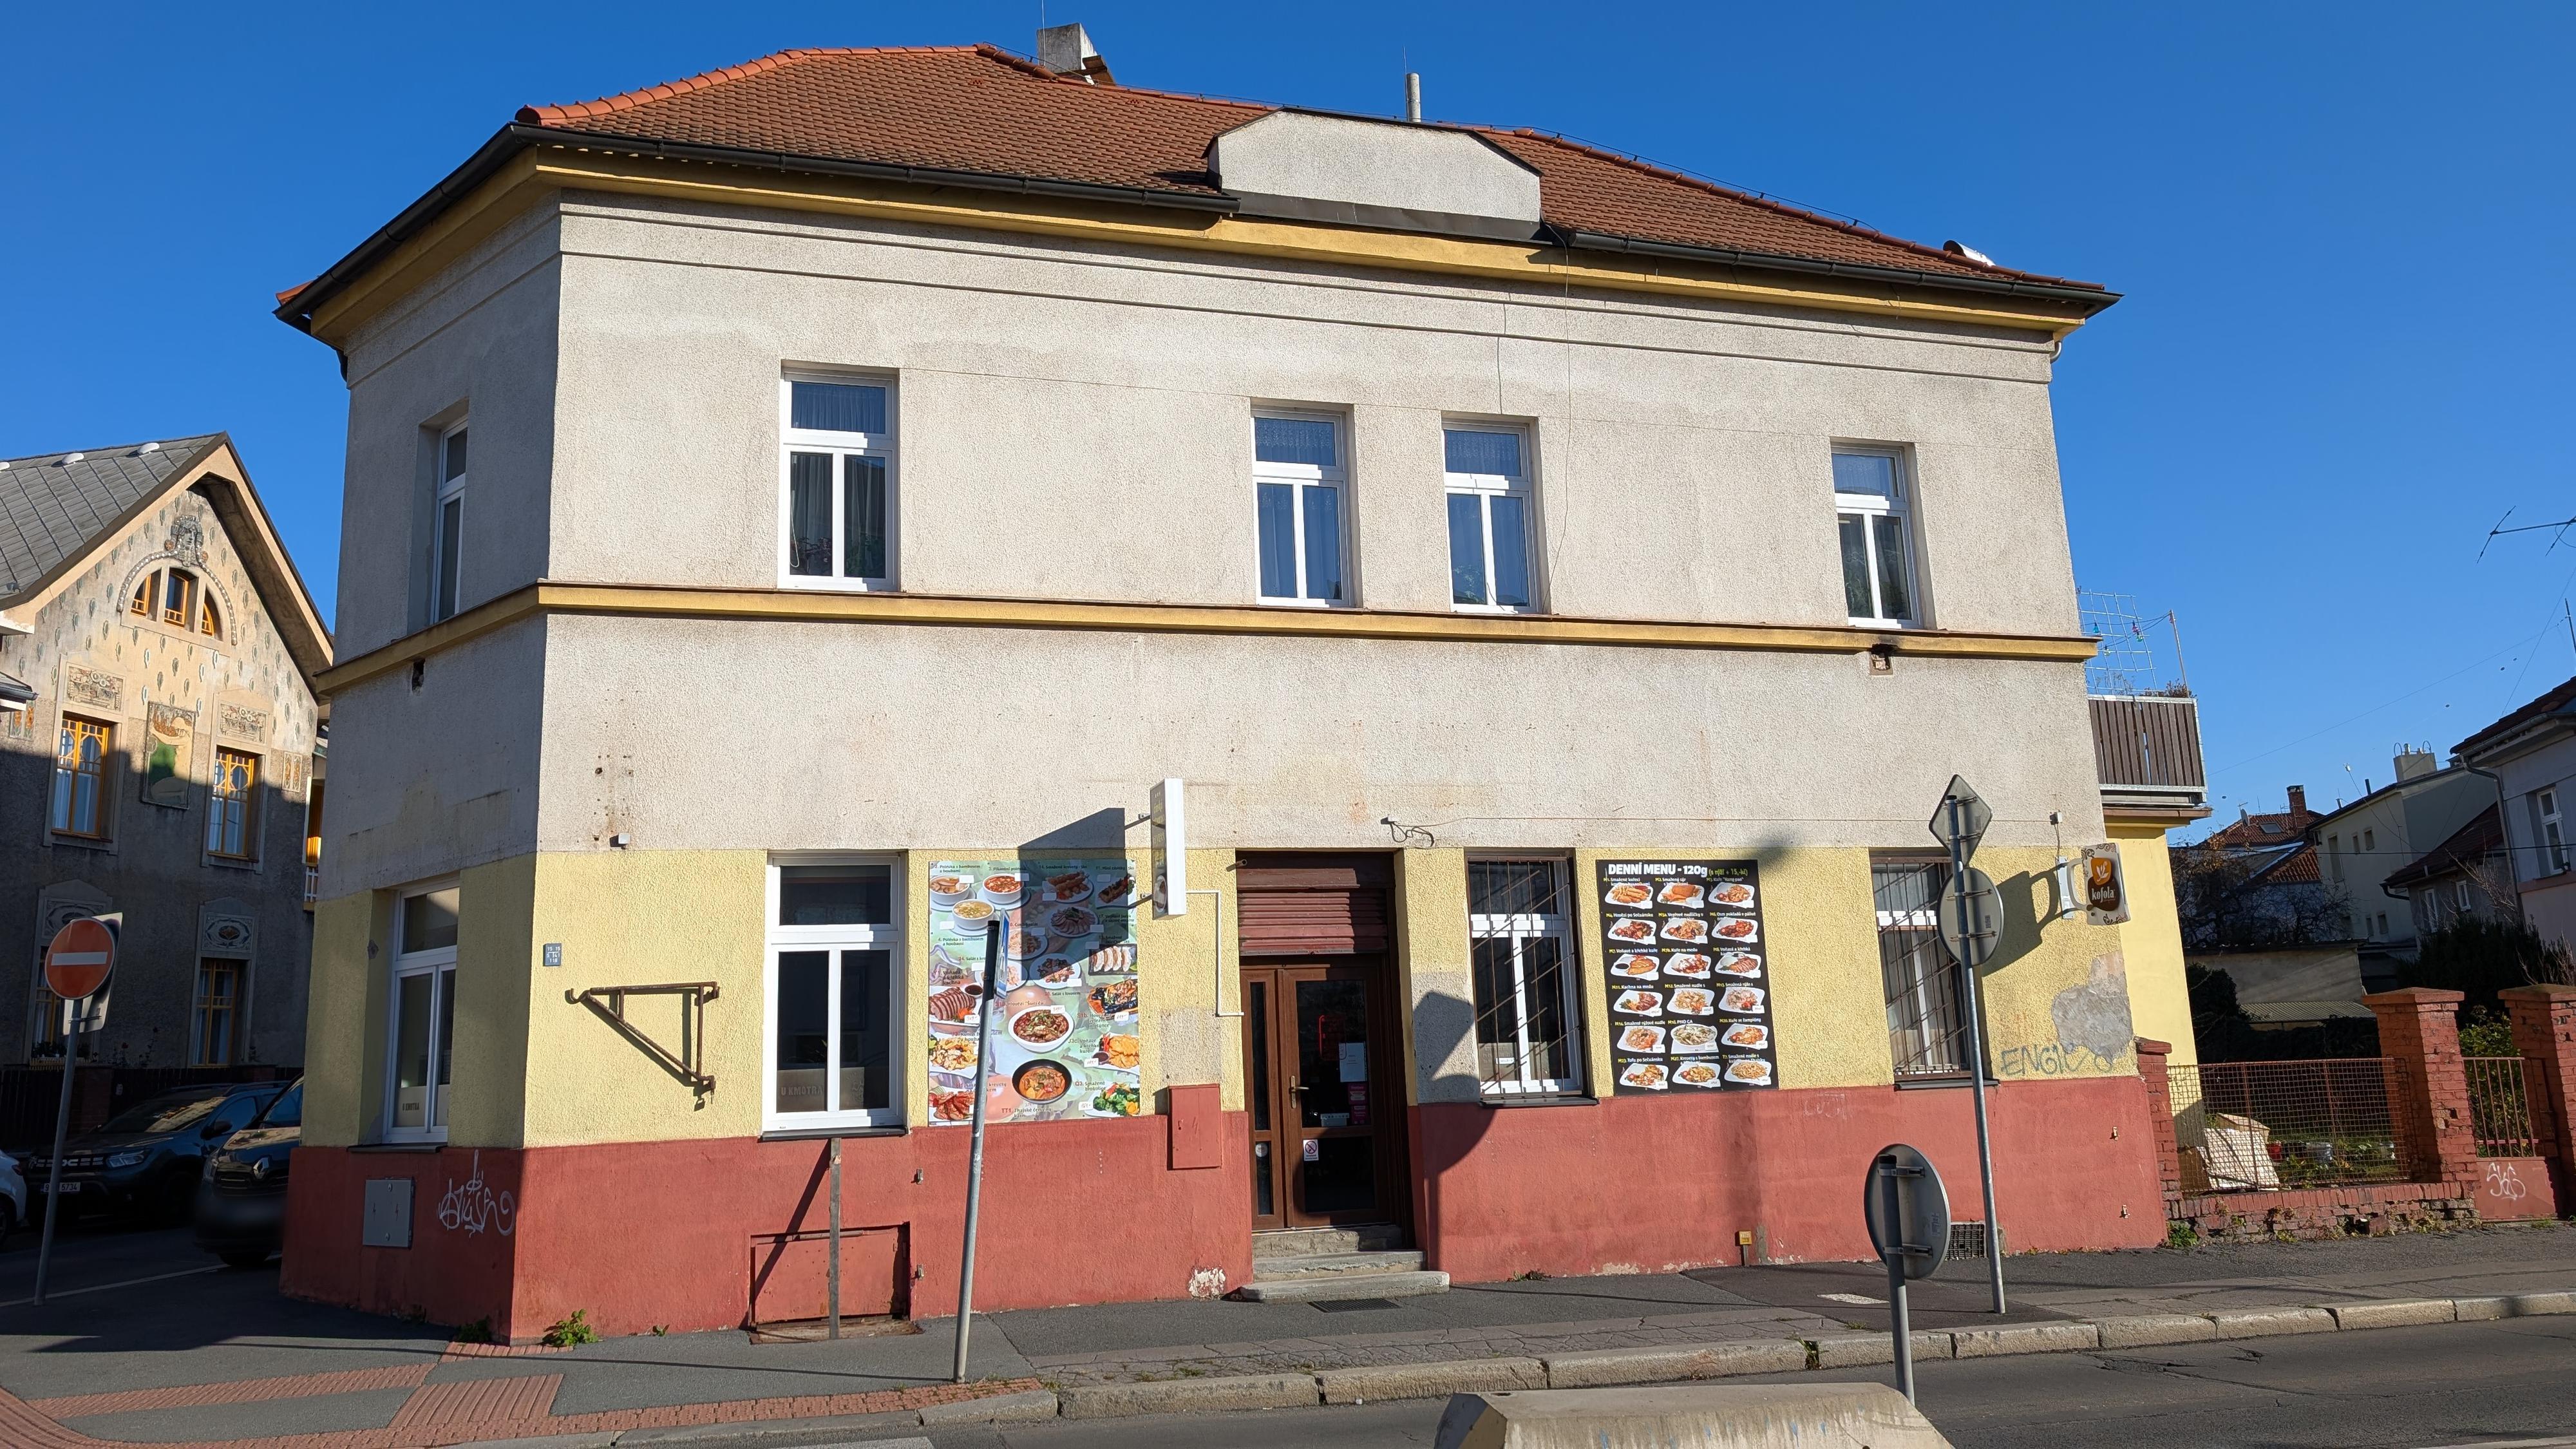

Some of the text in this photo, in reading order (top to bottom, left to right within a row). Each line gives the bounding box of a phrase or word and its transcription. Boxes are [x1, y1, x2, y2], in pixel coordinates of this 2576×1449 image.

[1608, 862, 1643, 875] DENNÍ
[1643, 863, 1676, 875] MENU
[1683, 865, 1708, 878] 120g
[2091, 886, 2114, 903] kofola
[781, 1085, 823, 1095] U KMOTRA
